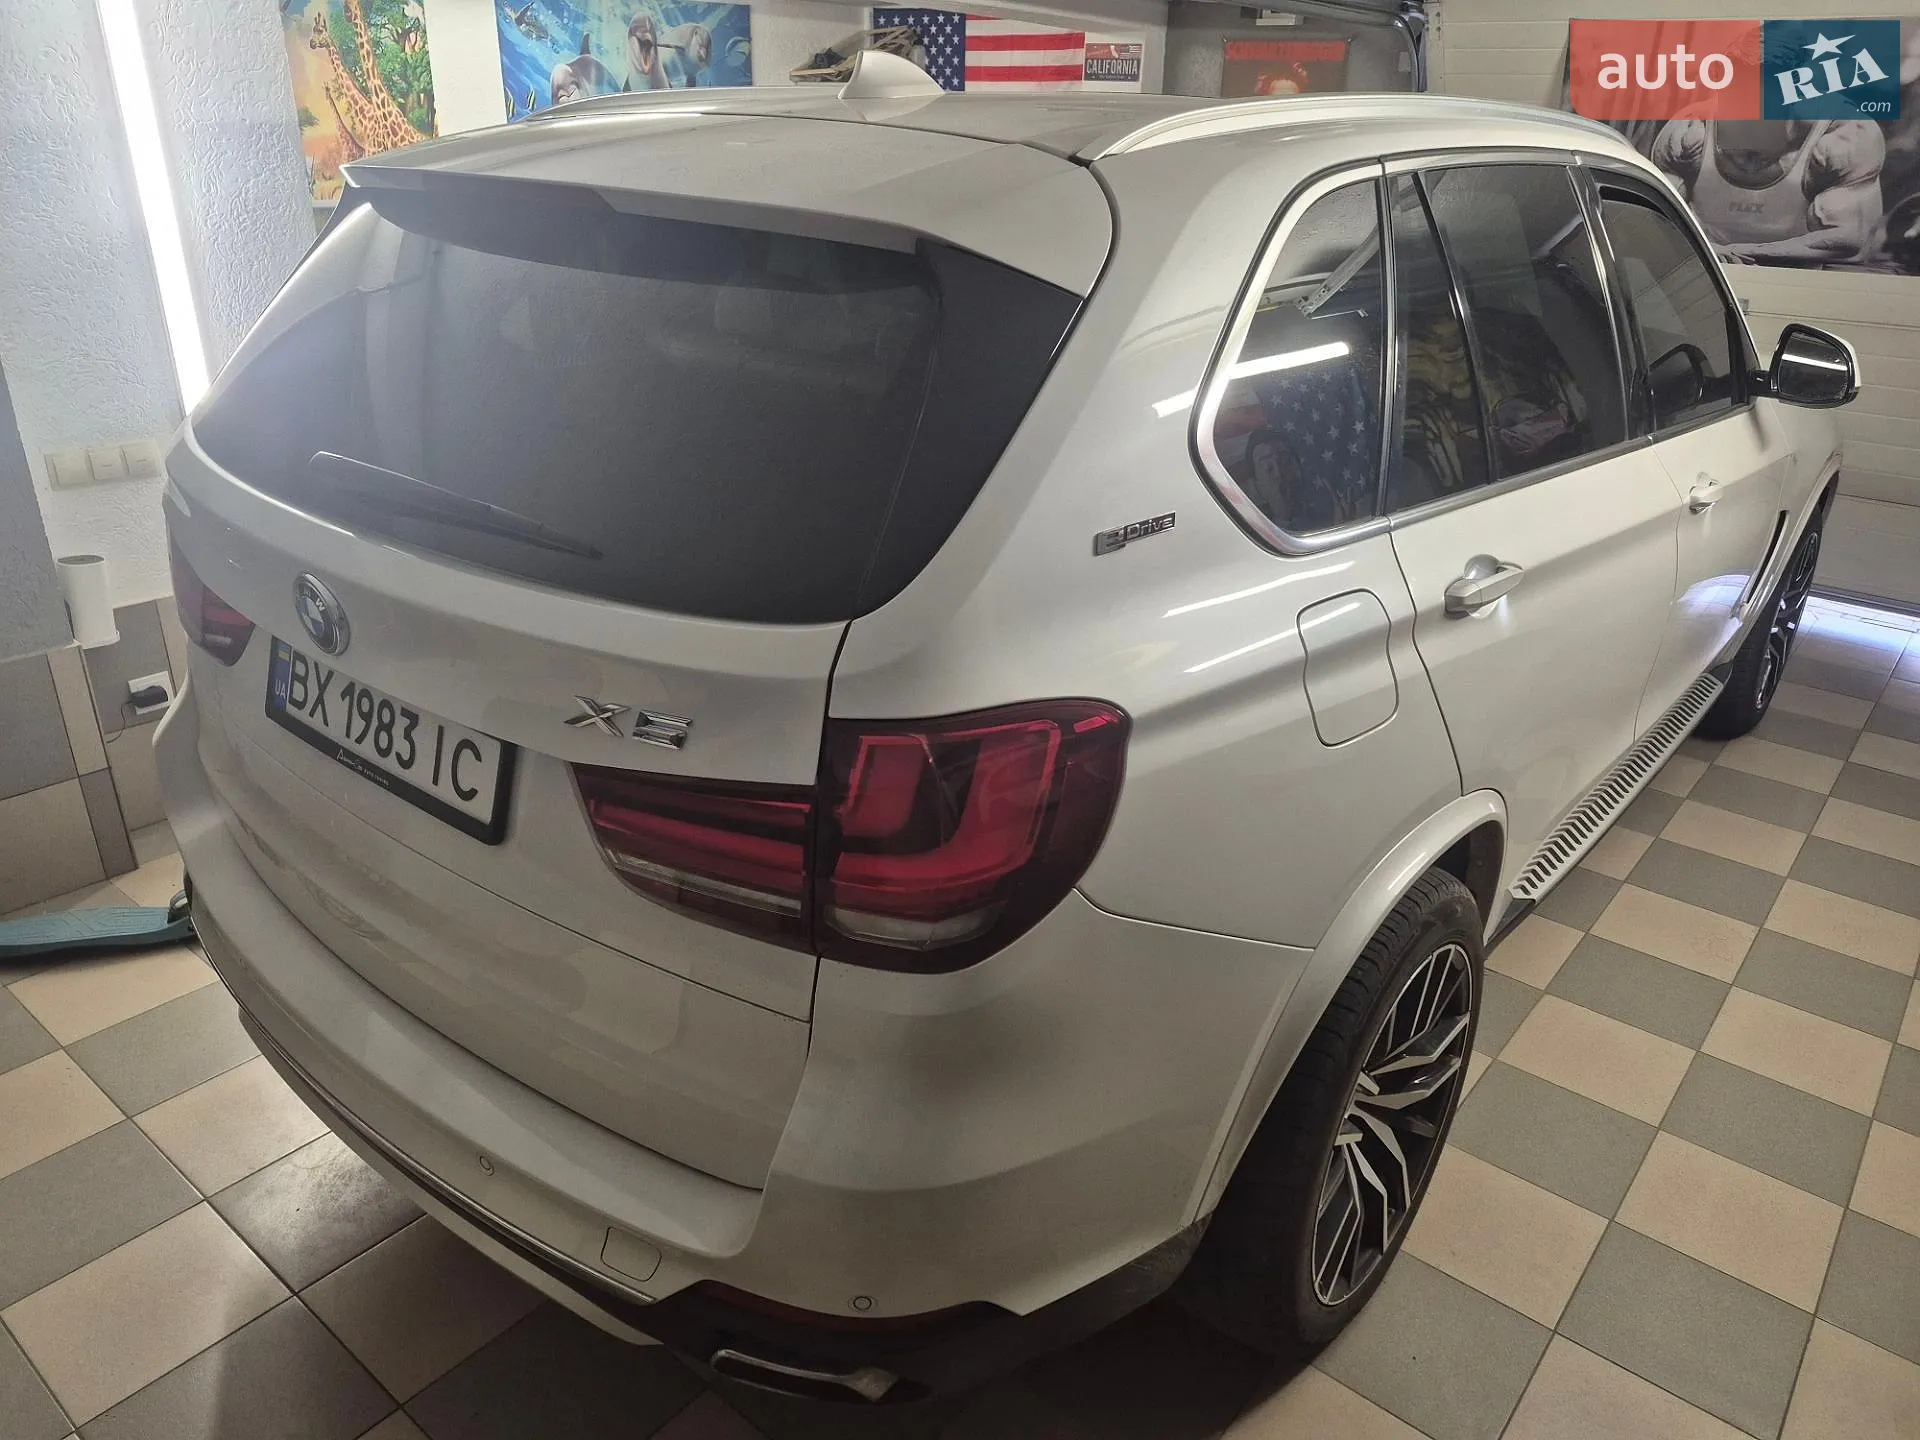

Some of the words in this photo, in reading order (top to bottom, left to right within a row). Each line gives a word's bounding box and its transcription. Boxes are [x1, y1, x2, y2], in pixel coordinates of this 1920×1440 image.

[1086, 59, 1138, 75] CALIFORNIA
[274, 679, 287, 698] UA
[288, 651, 334, 727] BX
[341, 681, 419, 770] 1983
[432, 724, 482, 801] IC
[563, 695, 692, 750] X5
